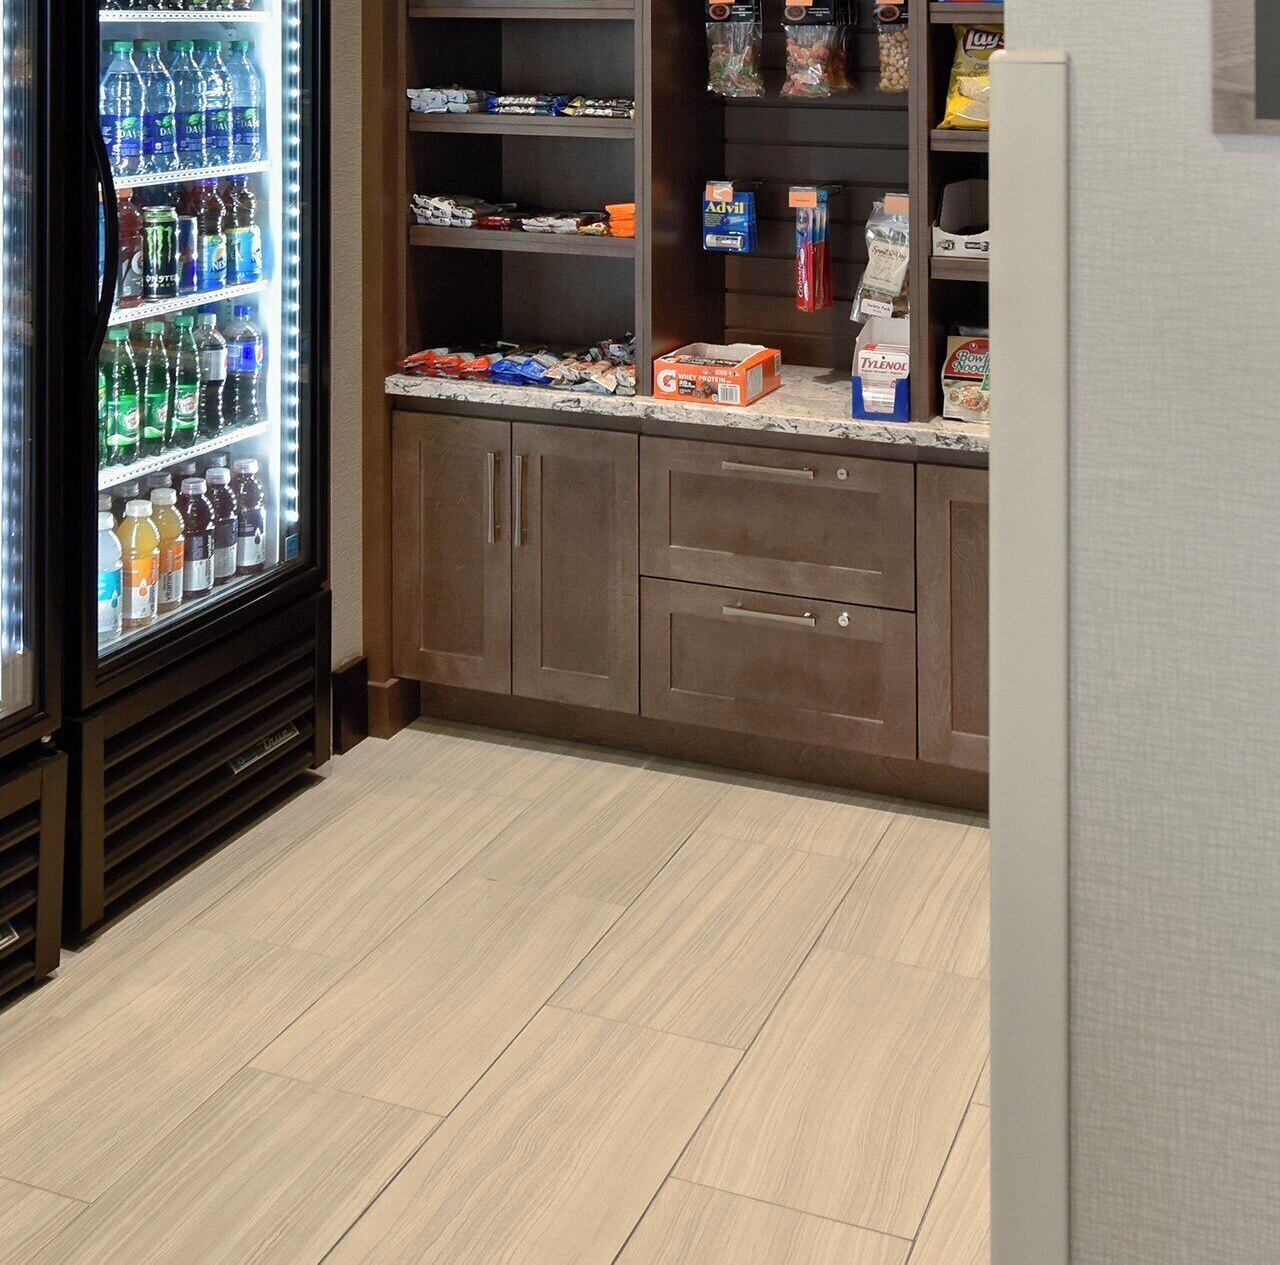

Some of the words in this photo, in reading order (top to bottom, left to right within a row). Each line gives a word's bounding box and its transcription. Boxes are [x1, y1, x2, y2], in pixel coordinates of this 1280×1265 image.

[705, 201, 744, 214] Advil
[861, 357, 907, 372] TYLENOL
[656, 369, 677, 393] G
[678, 373, 697, 381] WHEY
[698, 375, 726, 383] PROTEIN
